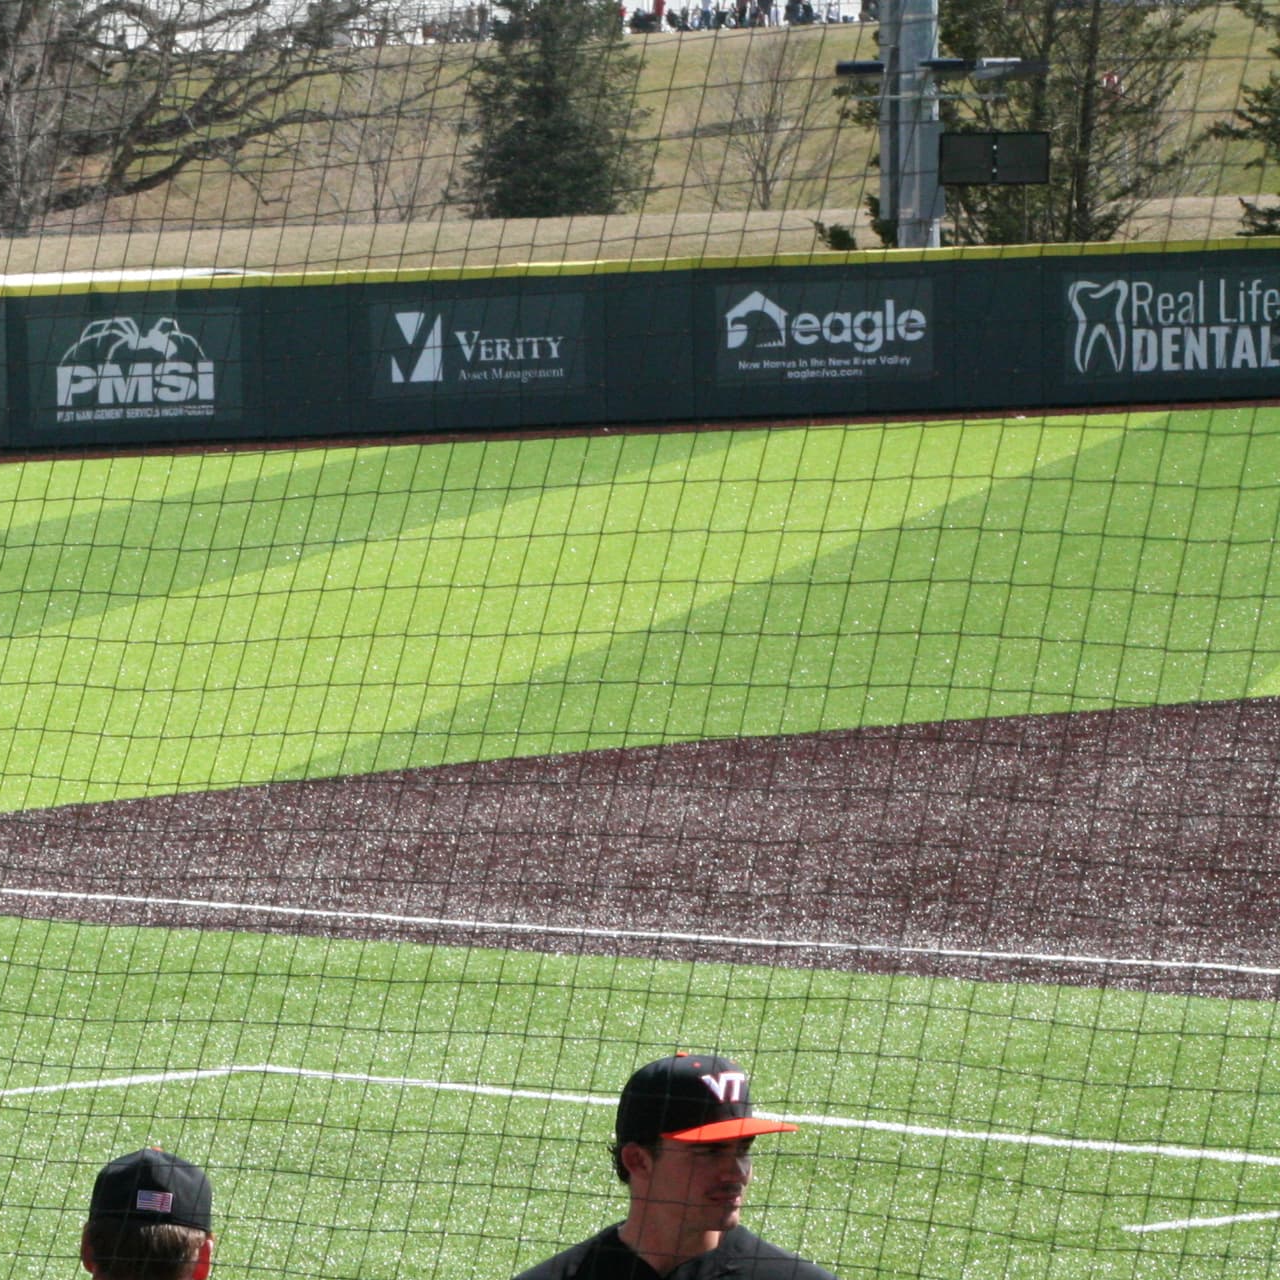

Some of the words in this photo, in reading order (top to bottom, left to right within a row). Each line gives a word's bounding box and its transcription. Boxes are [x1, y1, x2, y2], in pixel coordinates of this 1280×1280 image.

[1131, 279, 1205, 326] Real
[1219, 278, 1280, 323] Life
[791, 298, 927, 353] eagle
[454, 329, 564, 363] VERITY
[738, 361, 761, 370] New
[763, 359, 798, 369] Homes
[799, 358, 808, 368] in
[809, 358, 826, 367] the
[827, 357, 851, 367] New
[853, 356, 877, 366] River
[879, 354, 911, 366] Valley
[1131, 325, 1280, 372] DENTAL
[55, 360, 215, 407] PMSI
[457, 368, 488, 381] Asset
[490, 367, 564, 383] Management
[701, 1071, 746, 1102] VT
